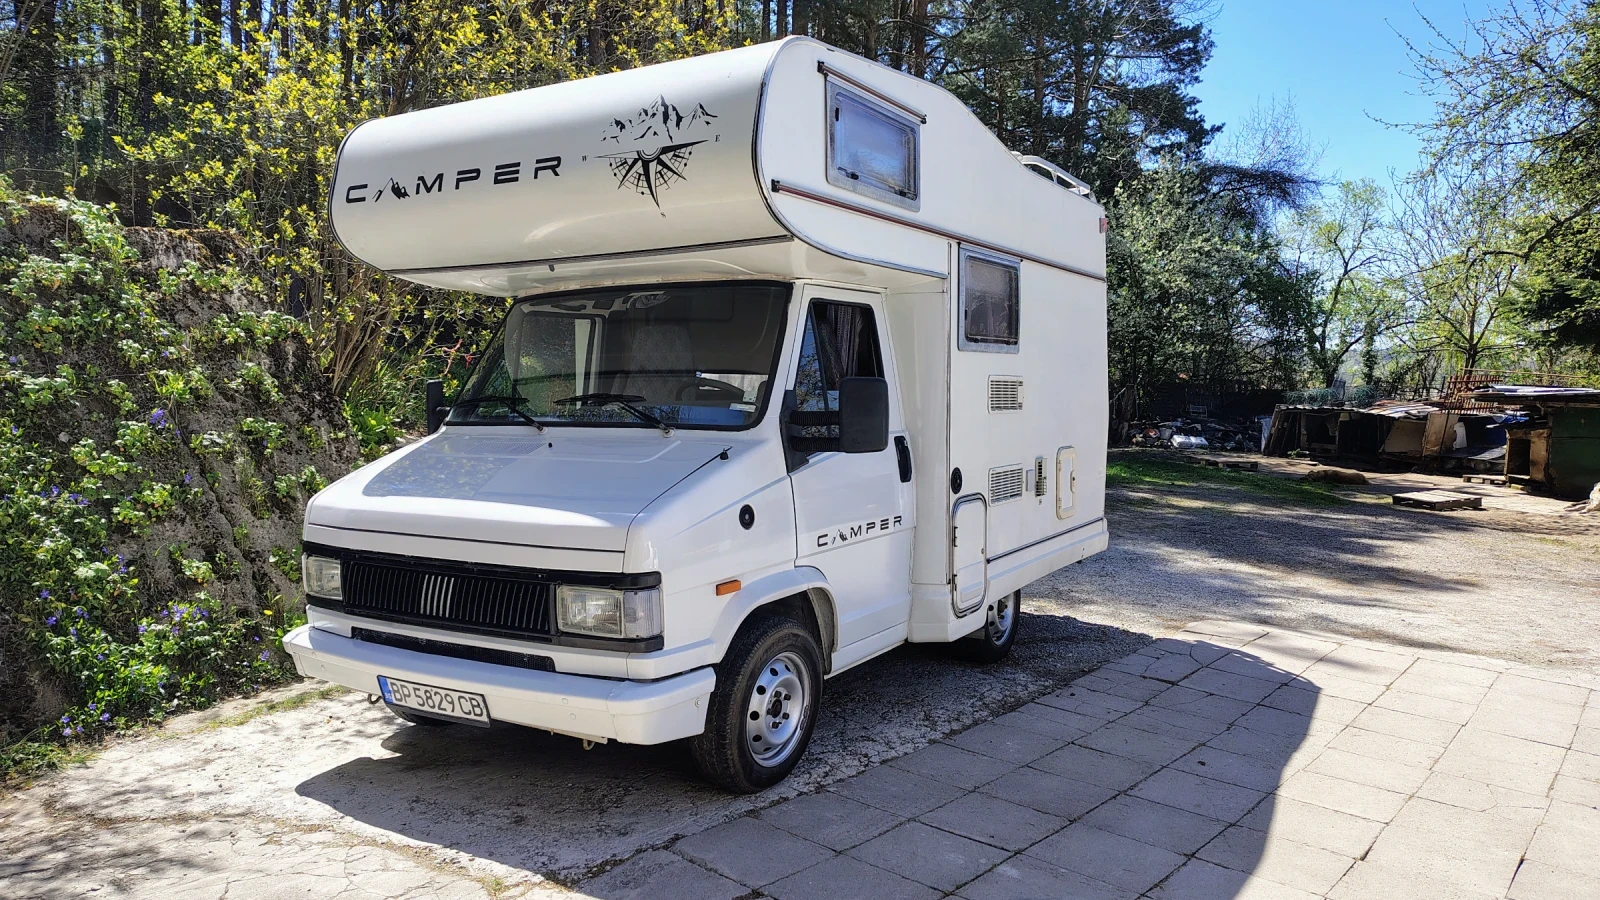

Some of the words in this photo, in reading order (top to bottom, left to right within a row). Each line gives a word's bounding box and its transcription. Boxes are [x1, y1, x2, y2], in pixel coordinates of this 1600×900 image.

[345, 155, 562, 204] CAMPER
[817, 515, 902, 547] CAMPER
[390, 682, 411, 703] BP
[413, 687, 455, 712] 5829
[458, 695, 483, 717] CB
